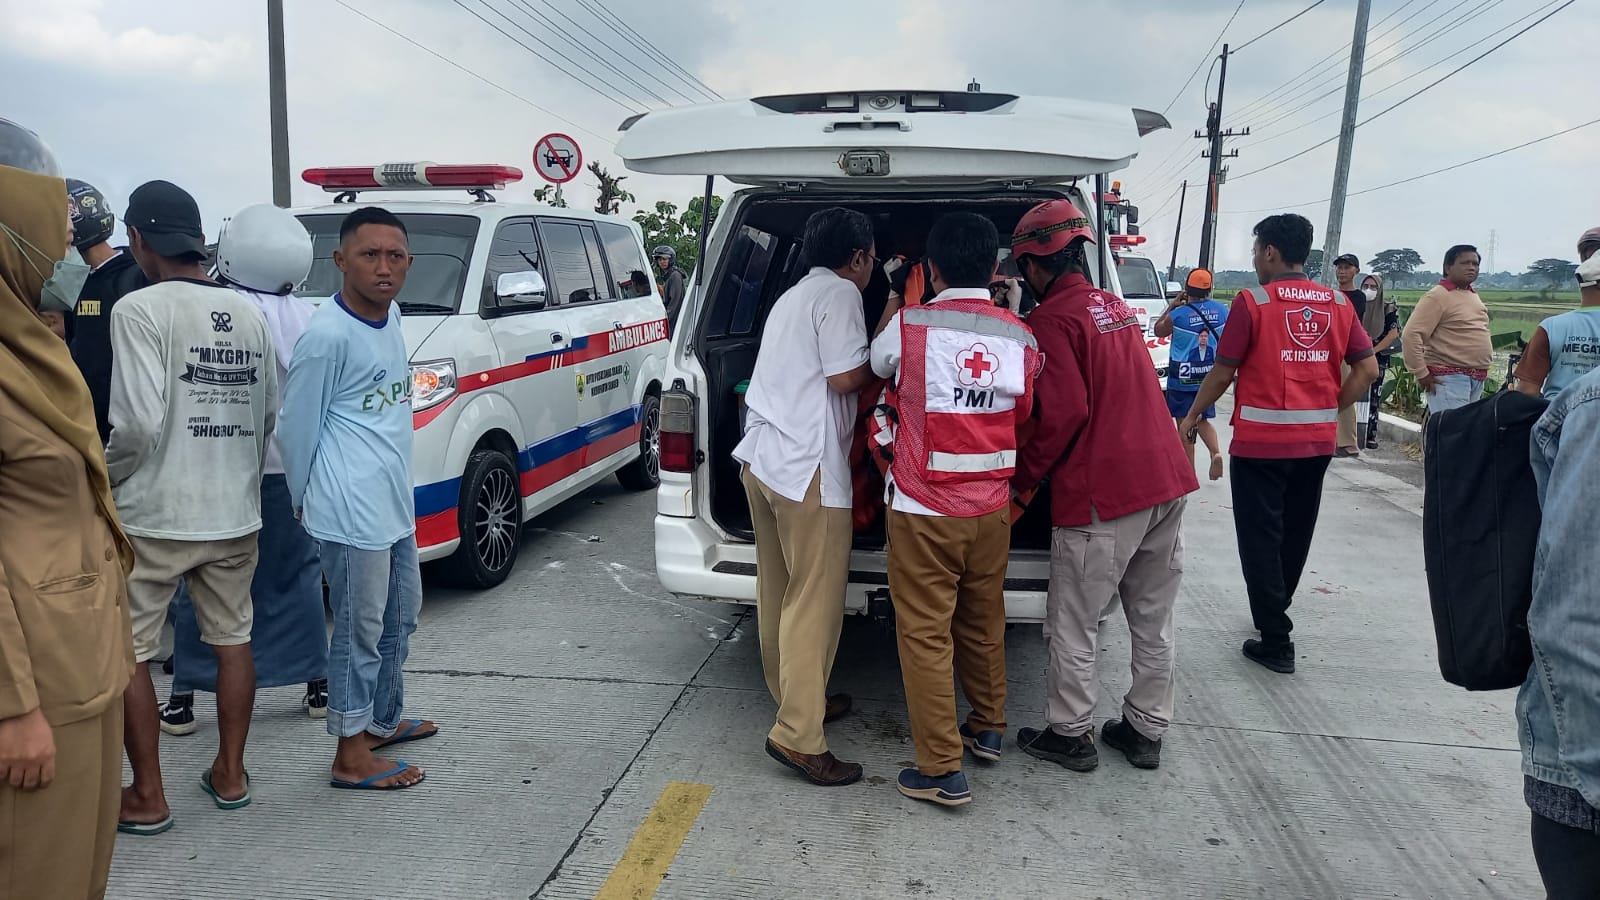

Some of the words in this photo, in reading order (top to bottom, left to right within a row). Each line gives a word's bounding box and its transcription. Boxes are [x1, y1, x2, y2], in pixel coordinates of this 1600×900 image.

[1278, 287, 1332, 302] PARAMEDIS
[1298, 322, 1318, 332] 119
[608, 320, 666, 353] AMBULANCE
[1281, 350, 1293, 361] PSC
[1294, 350, 1306, 361] 119
[954, 387, 994, 408] PMI
